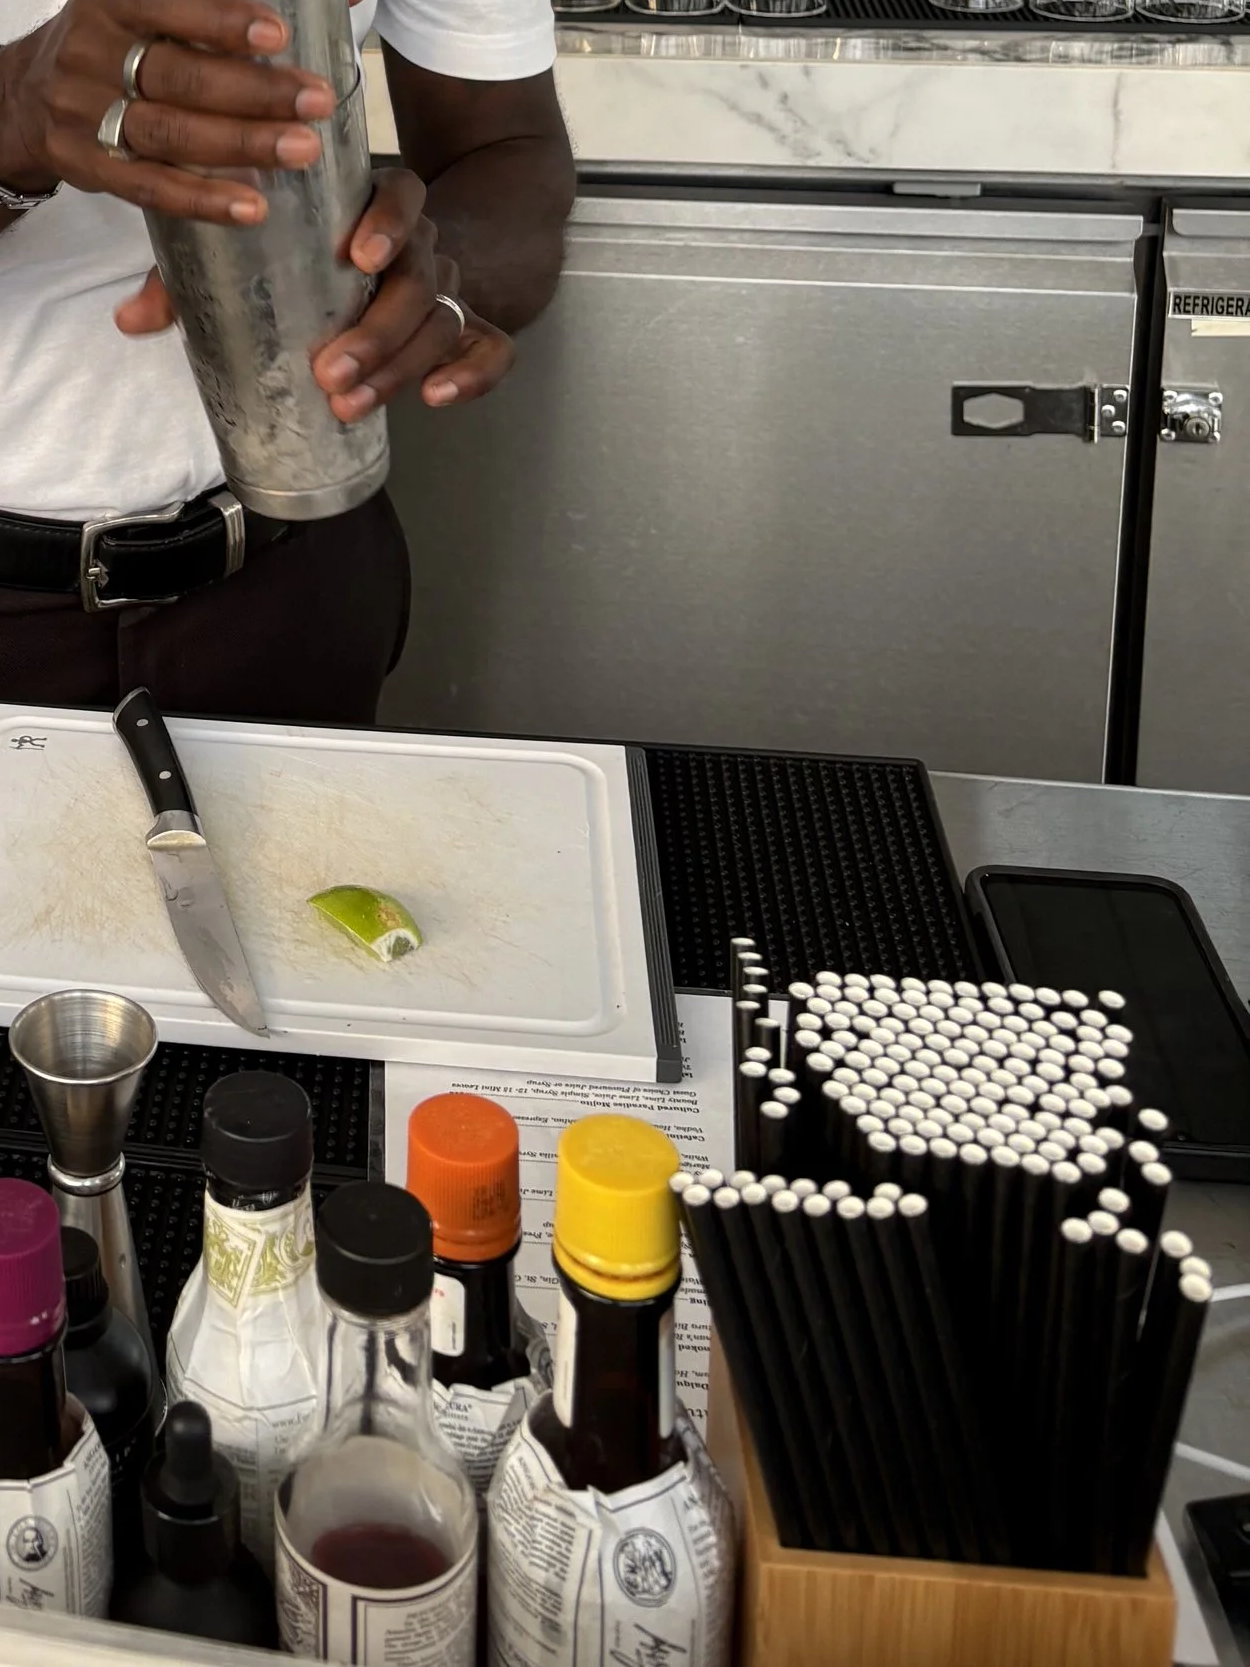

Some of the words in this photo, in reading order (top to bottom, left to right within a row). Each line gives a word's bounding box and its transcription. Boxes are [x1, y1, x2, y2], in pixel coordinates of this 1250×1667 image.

[451, 1083, 479, 1091] Leaves
[526, 1079, 552, 1088] Syrup
[559, 1090, 590, 1098] Simple
[642, 1088, 671, 1096] Choice
[580, 1099, 611, 1108] Mojito
[612, 1102, 655, 1111] Paradise
[657, 1105, 700, 1114] Cultured
[531, 1189, 554, 1197] Lime
